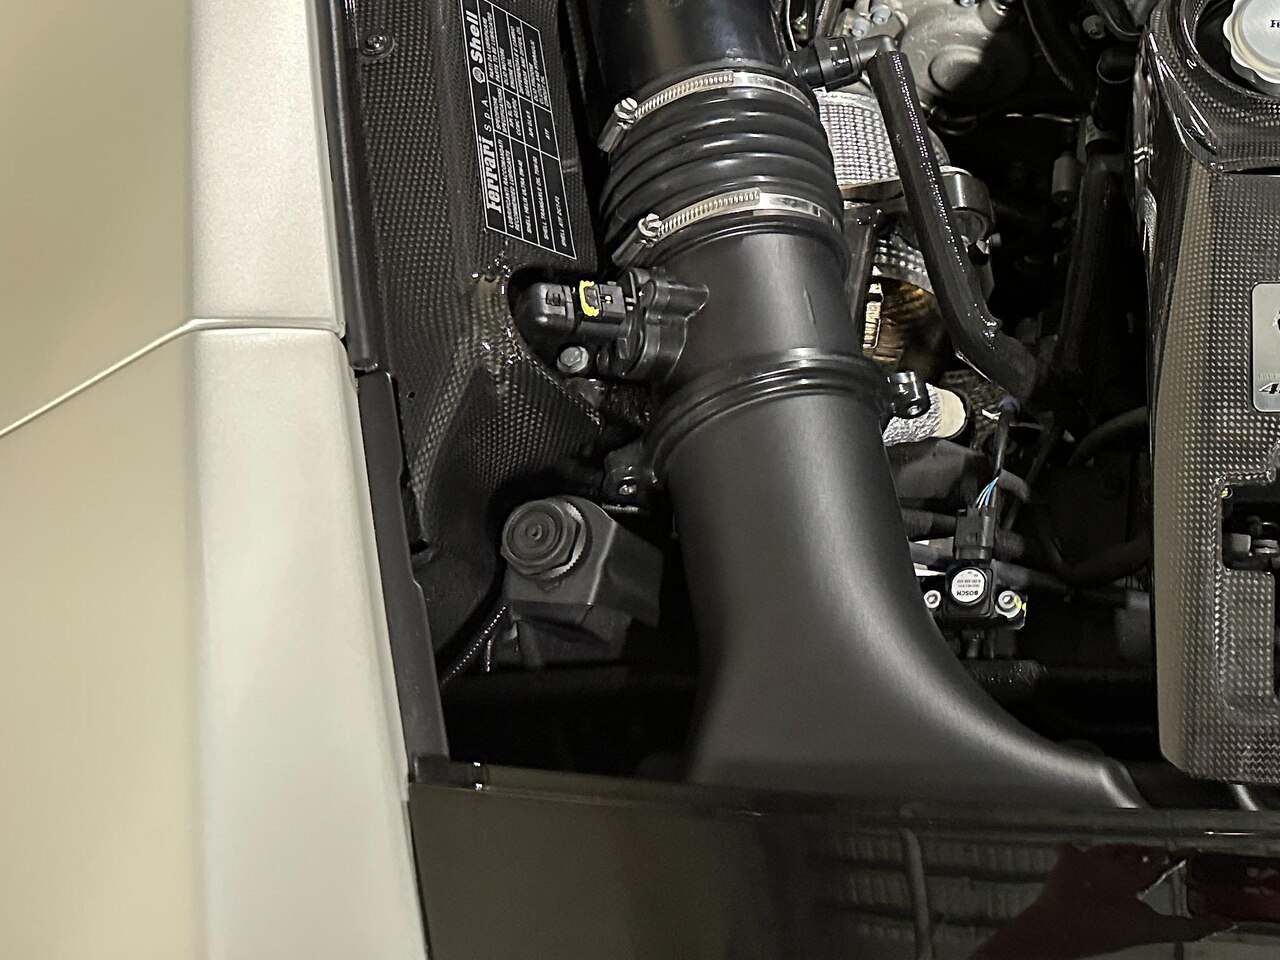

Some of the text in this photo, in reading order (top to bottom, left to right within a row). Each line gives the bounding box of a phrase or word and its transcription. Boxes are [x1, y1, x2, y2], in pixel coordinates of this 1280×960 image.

[465, 8, 483, 65] Shell
[478, 134, 502, 213] Ferrari
[519, 176, 527, 196] ULTRA
[524, 214, 532, 234] SHELL
[541, 220, 549, 240] SHELL
[559, 227, 567, 247] SHELL
